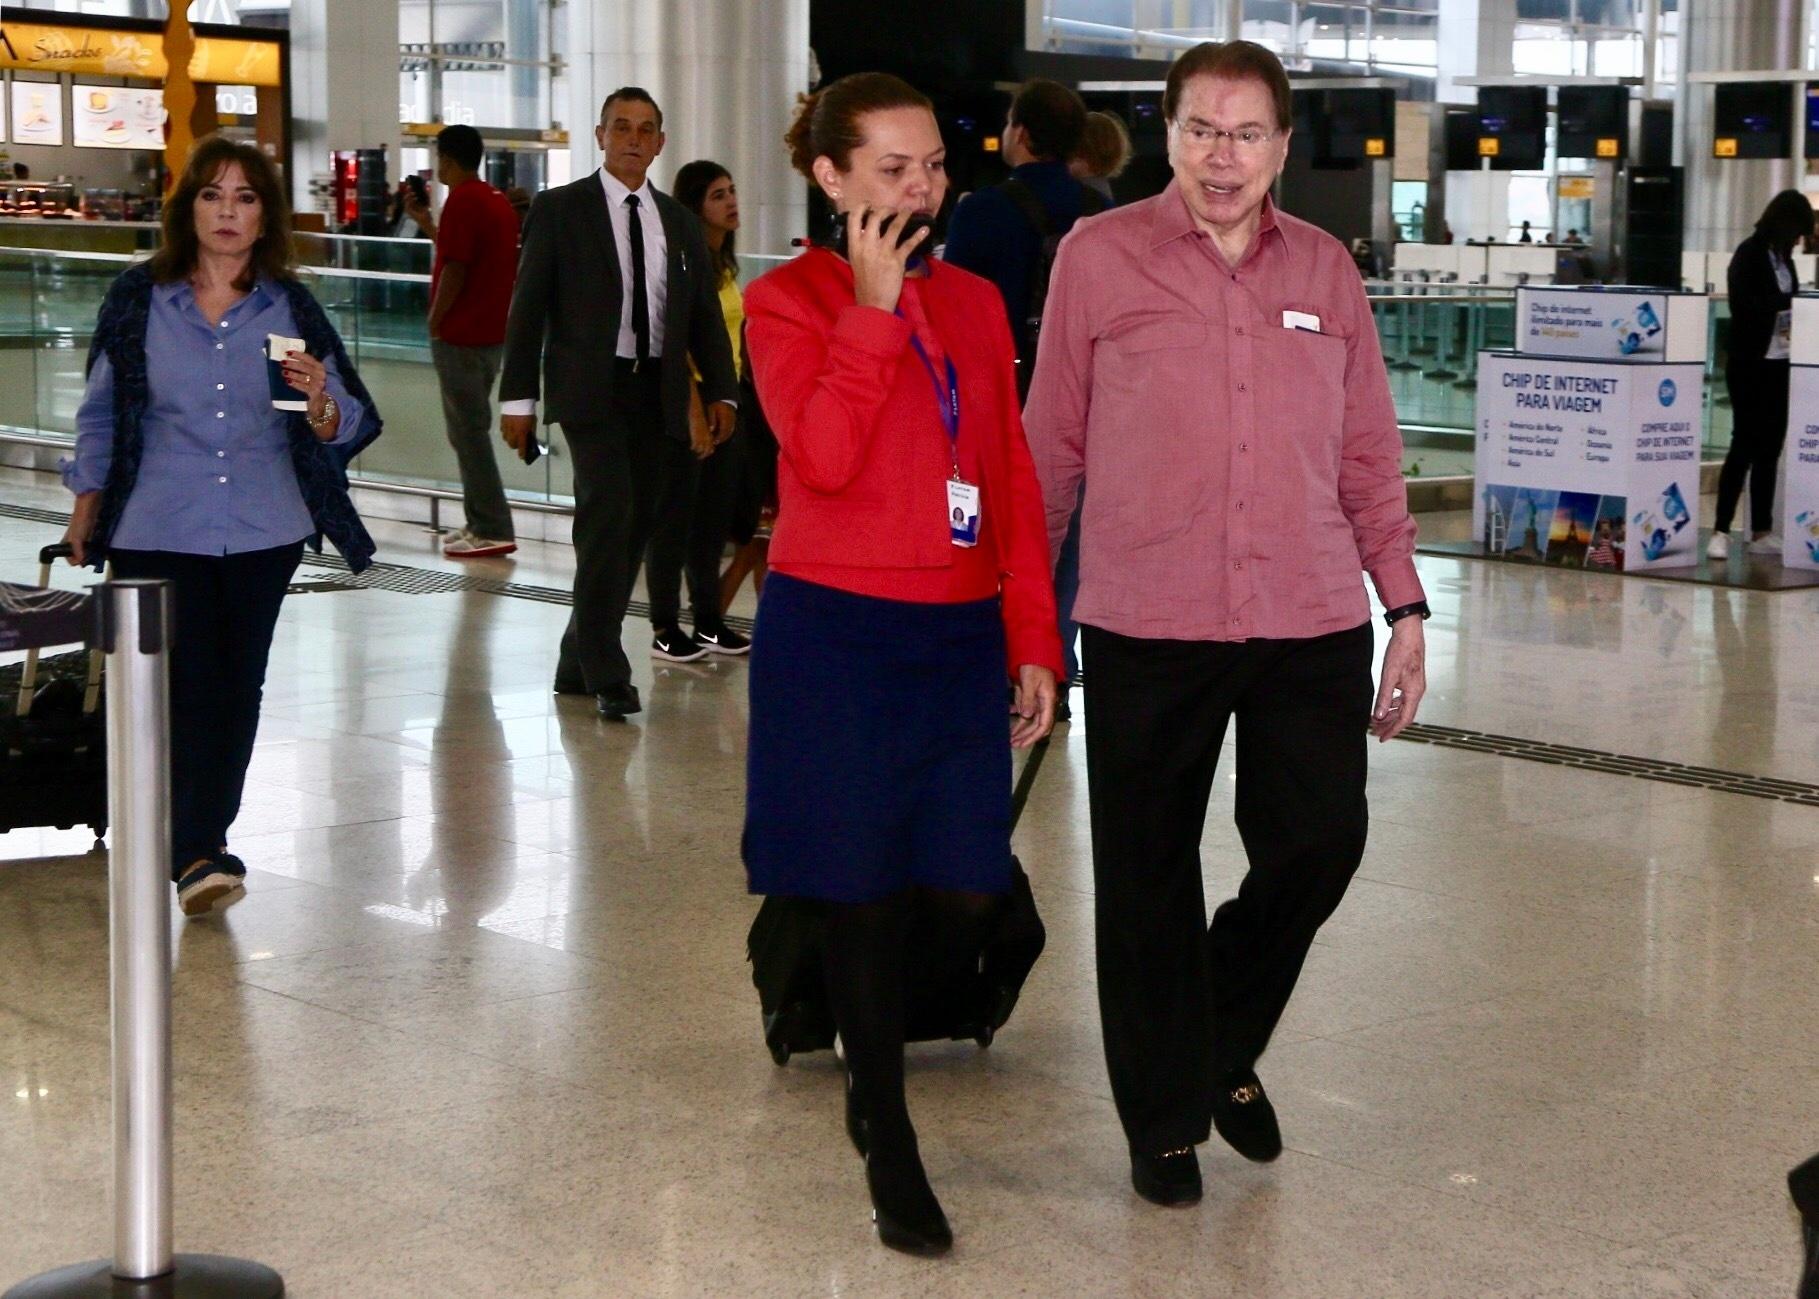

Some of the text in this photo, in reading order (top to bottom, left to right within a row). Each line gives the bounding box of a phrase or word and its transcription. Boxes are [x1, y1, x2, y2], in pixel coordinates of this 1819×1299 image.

[1503, 372, 1618, 394] CHIP DE INTERNET
[1516, 393, 1602, 412] PARA VIAGEM
[1546, 424, 1563, 432] Norte
[1642, 423, 1668, 433] COMPRE
[1637, 436, 1694, 448] CHIP DE INTERNET
